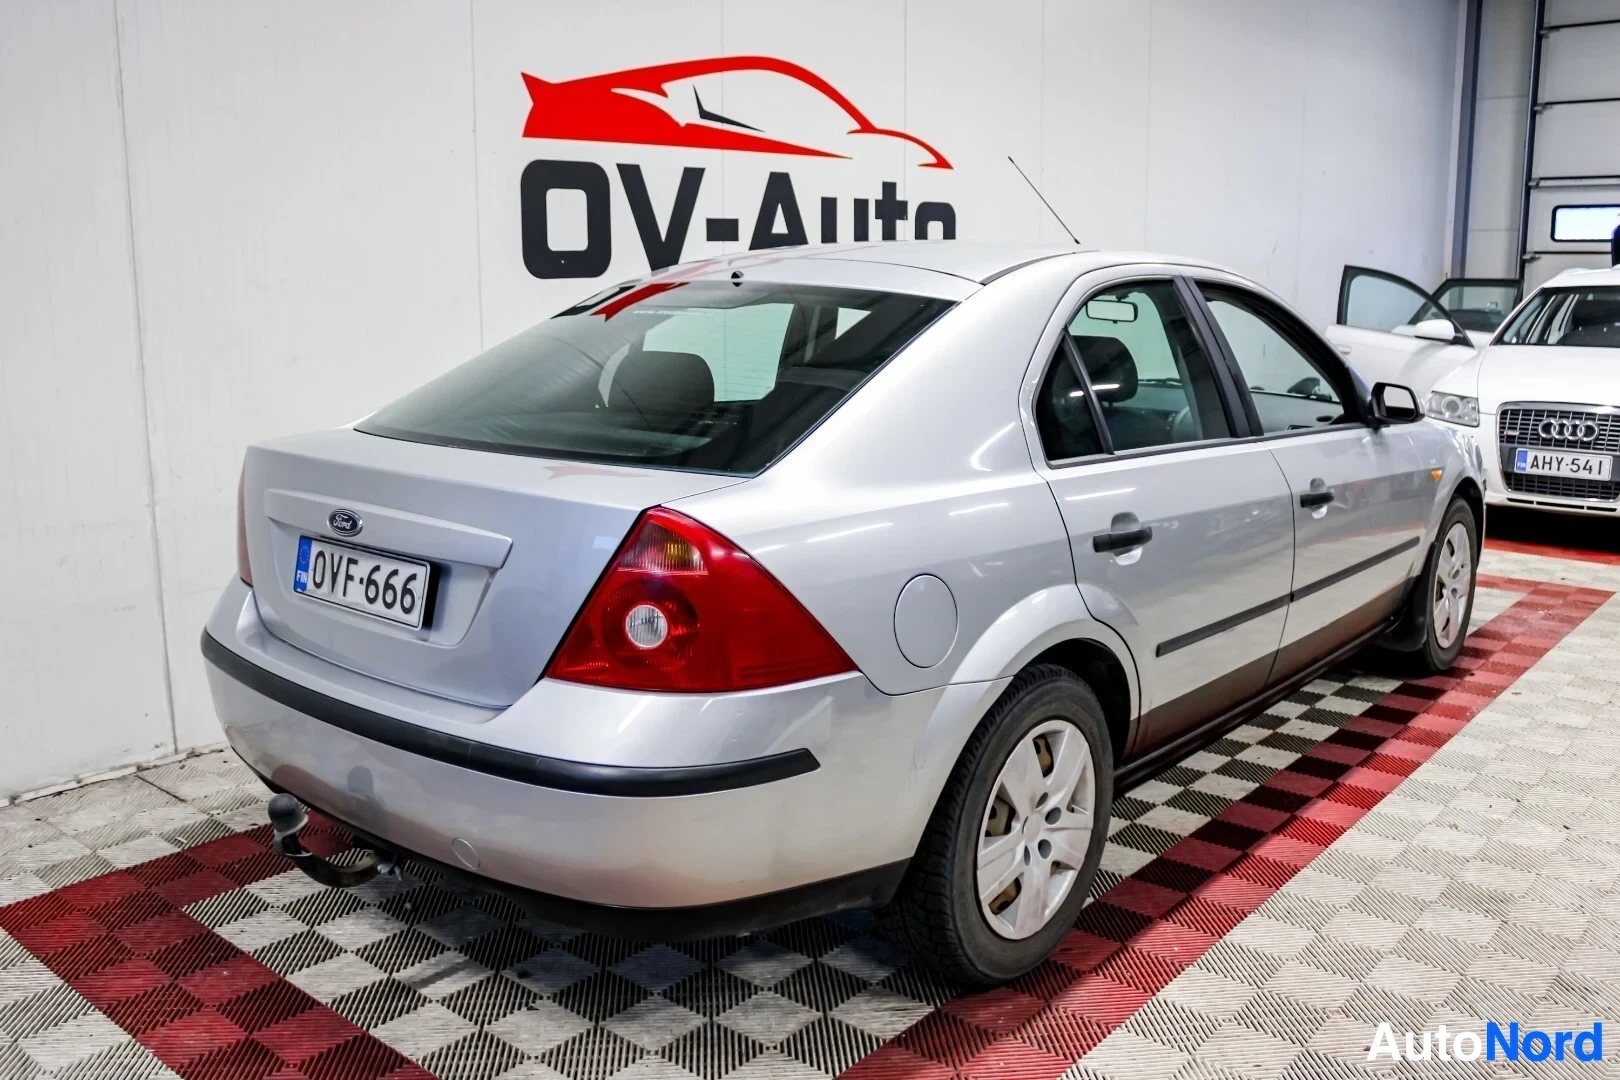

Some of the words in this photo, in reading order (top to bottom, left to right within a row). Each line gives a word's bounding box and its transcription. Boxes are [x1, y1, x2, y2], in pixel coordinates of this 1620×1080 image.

[520, 159, 956, 279] OV-Auto
[1530, 454, 1603, 475] AHY-541
[333, 513, 352, 530] Ford
[296, 570, 308, 583] FIN
[312, 550, 417, 615] OVF-666
